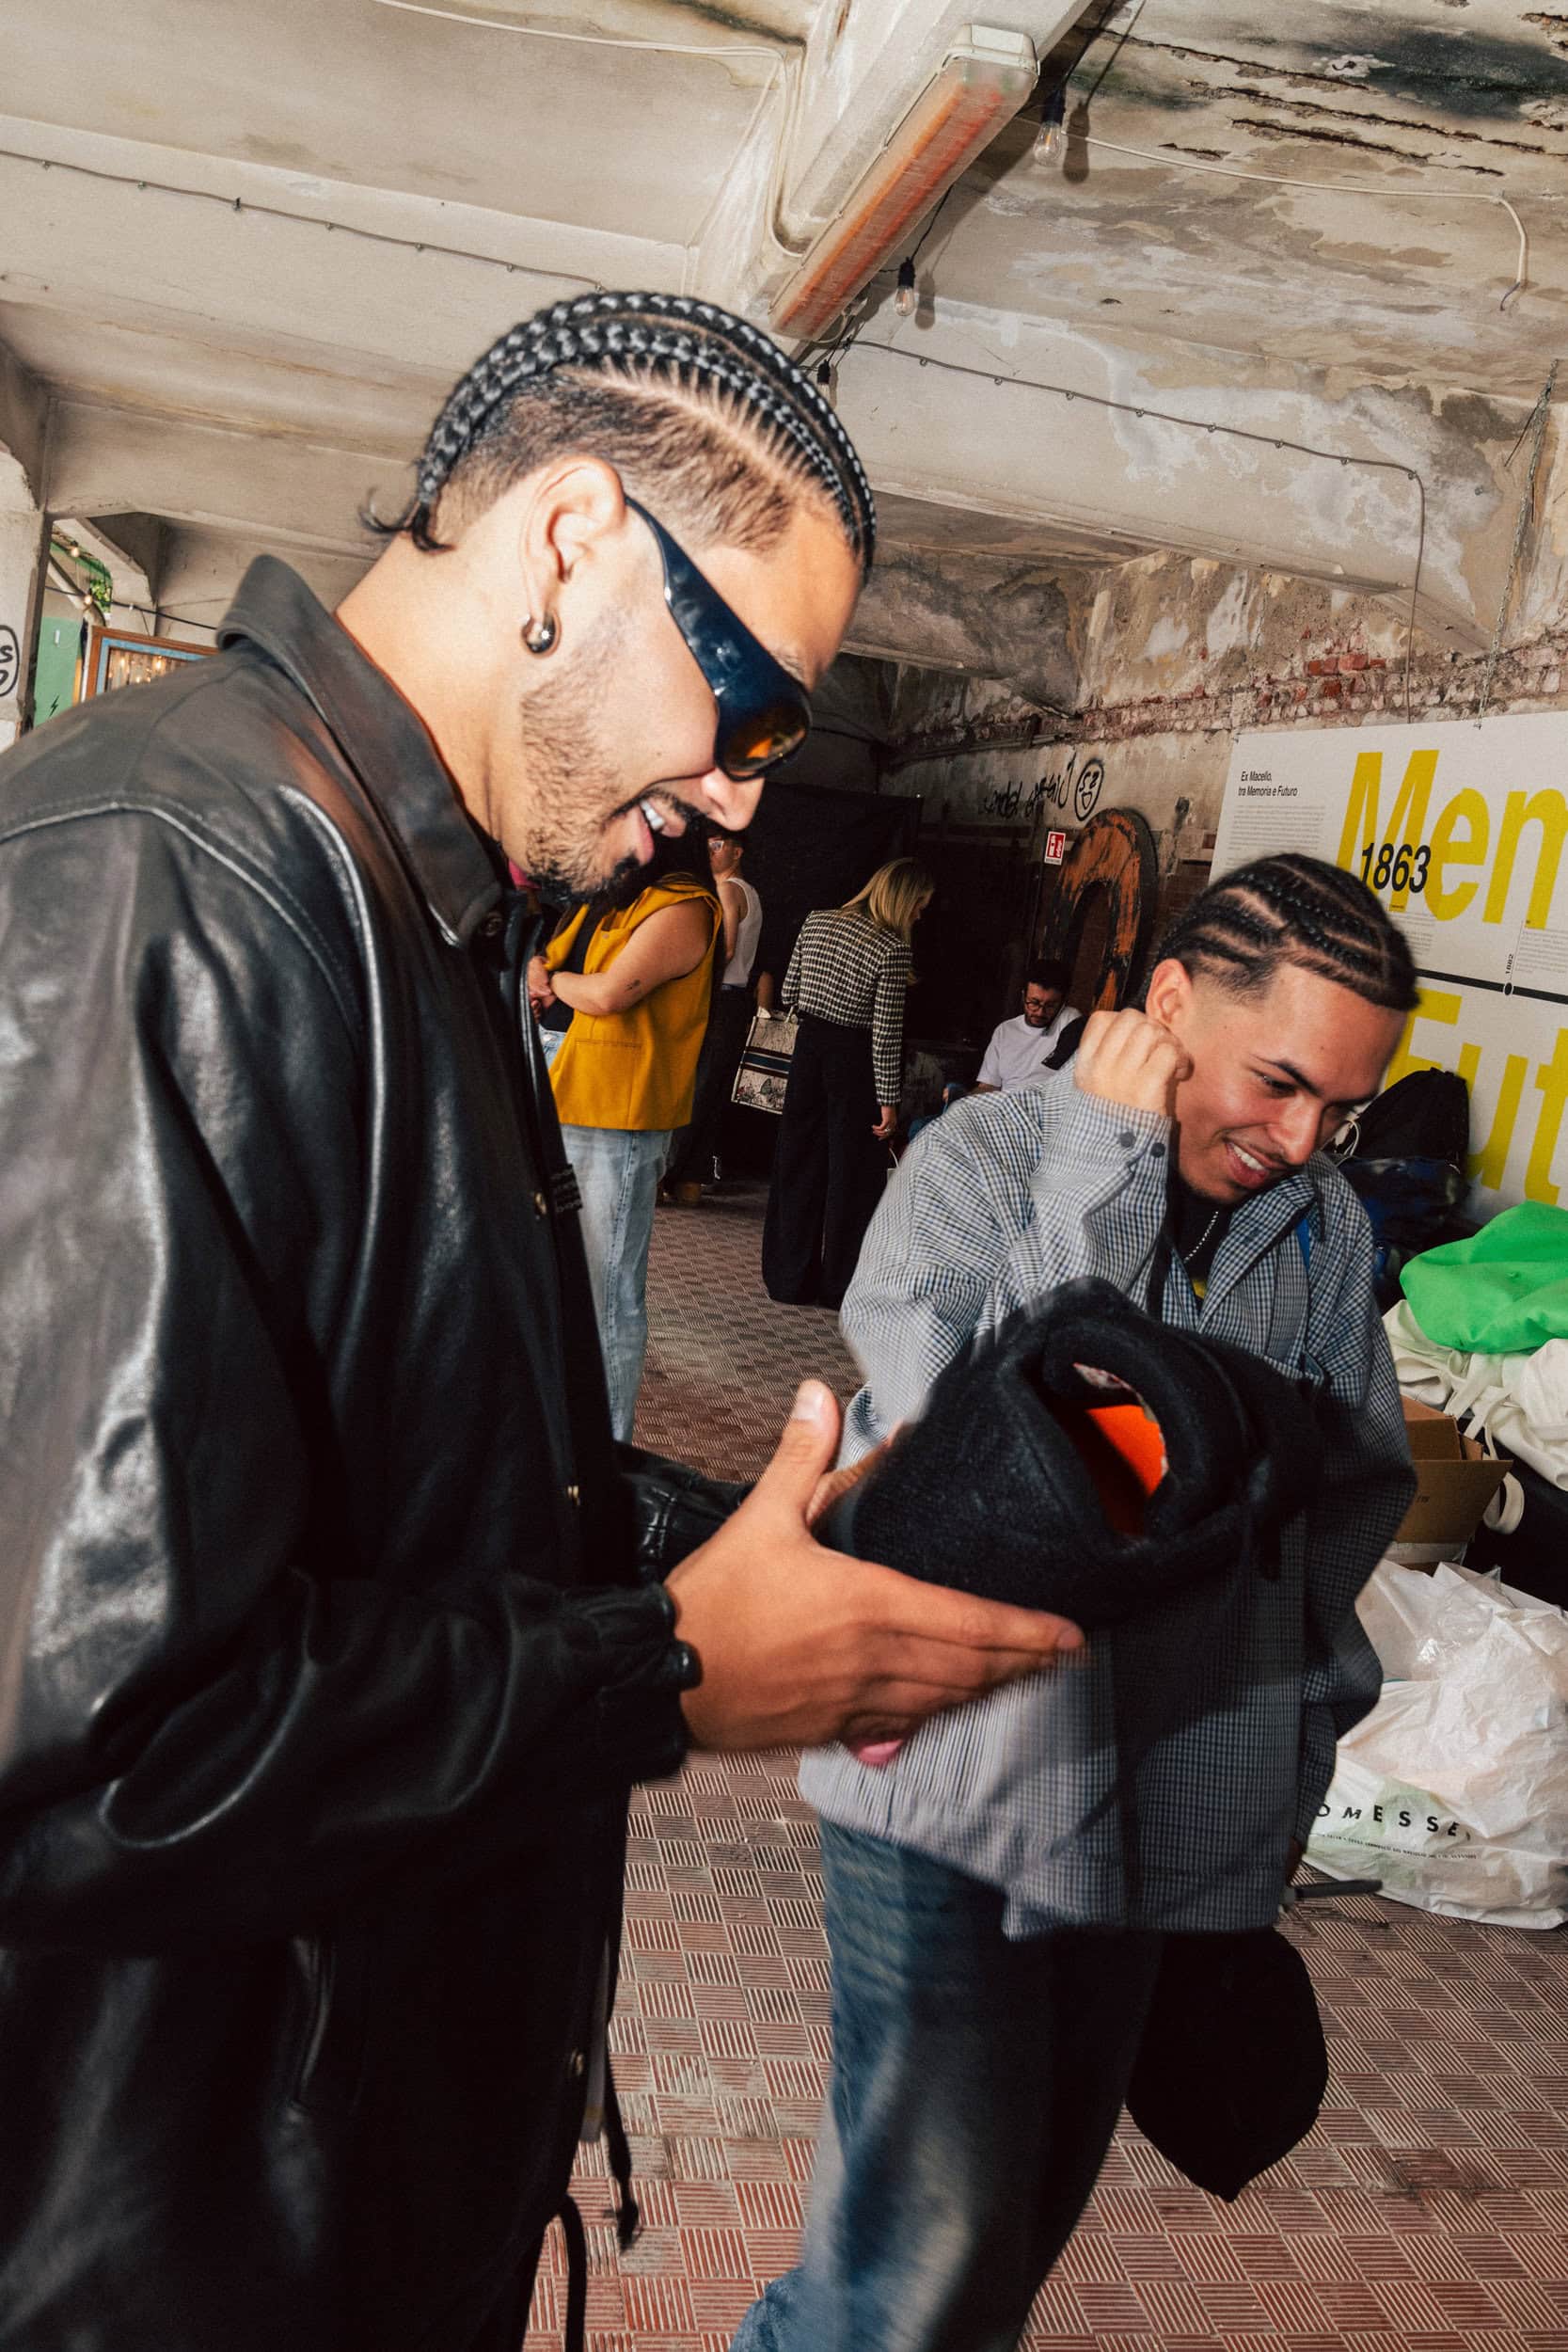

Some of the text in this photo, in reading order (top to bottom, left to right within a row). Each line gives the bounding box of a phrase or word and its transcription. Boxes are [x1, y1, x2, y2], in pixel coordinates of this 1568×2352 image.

[1241, 771, 1248, 781] Ex
[1238, 786, 1298, 796] tra Memoria e Futuro
[1362, 842, 1432, 894] 1863
